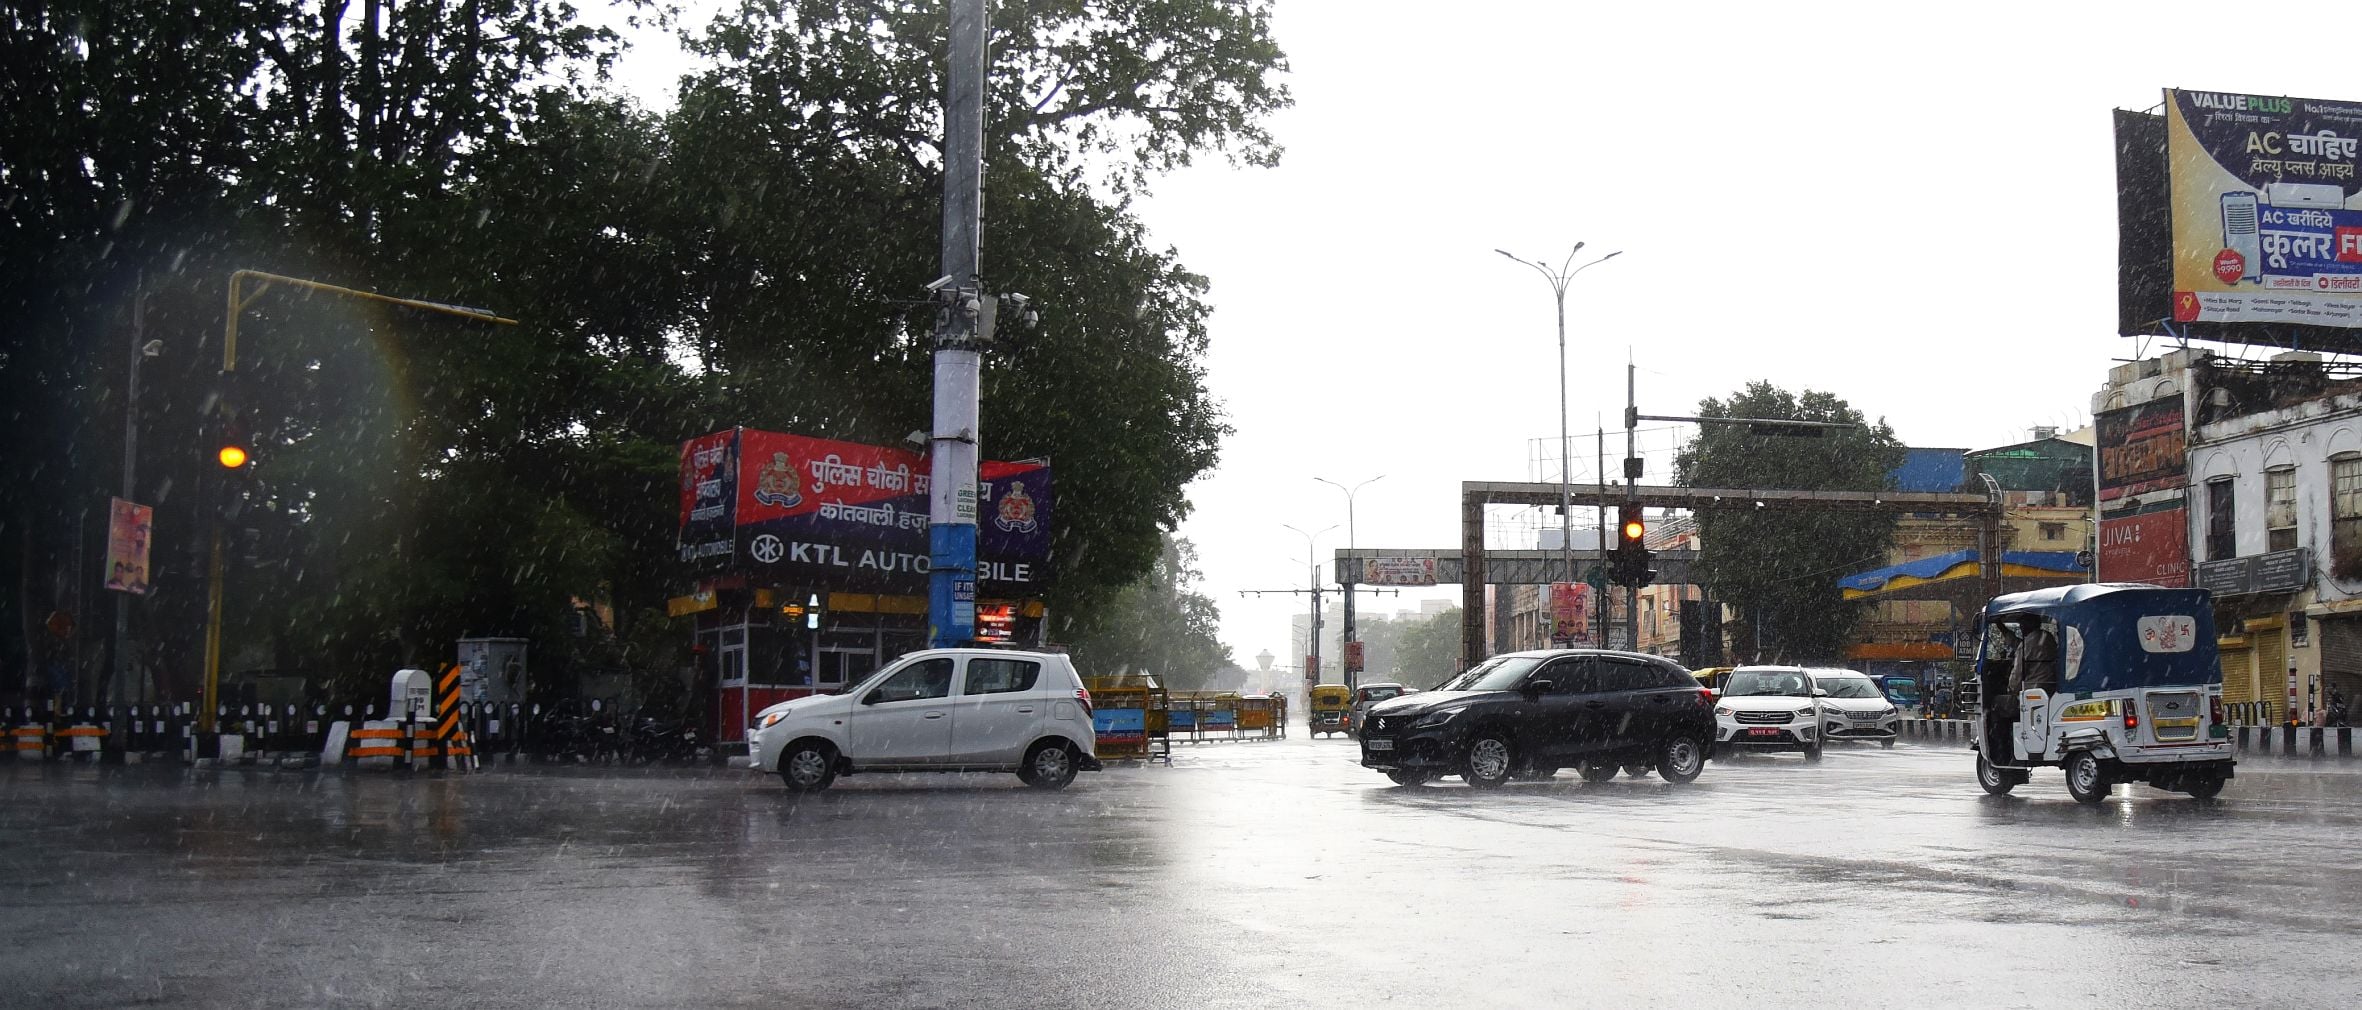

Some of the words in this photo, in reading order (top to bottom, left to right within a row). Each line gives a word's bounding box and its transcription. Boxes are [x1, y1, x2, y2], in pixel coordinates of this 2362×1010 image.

[2245, 131, 2282, 155] AC
[2286, 129, 2358, 161] चाहिए
[2261, 210, 2284, 224] AC
[2260, 229, 2333, 269] कूलर
[811, 454, 864, 494] पुलिस
[866, 460, 909, 493] चौकी
[820, 498, 896, 527] कोतवाली
[2103, 525, 2133, 547] JIVA
[790, 541, 849, 567] KTL
[2156, 562, 2185, 576] CLINIC
[1958, 647, 1972, 655] ATM
